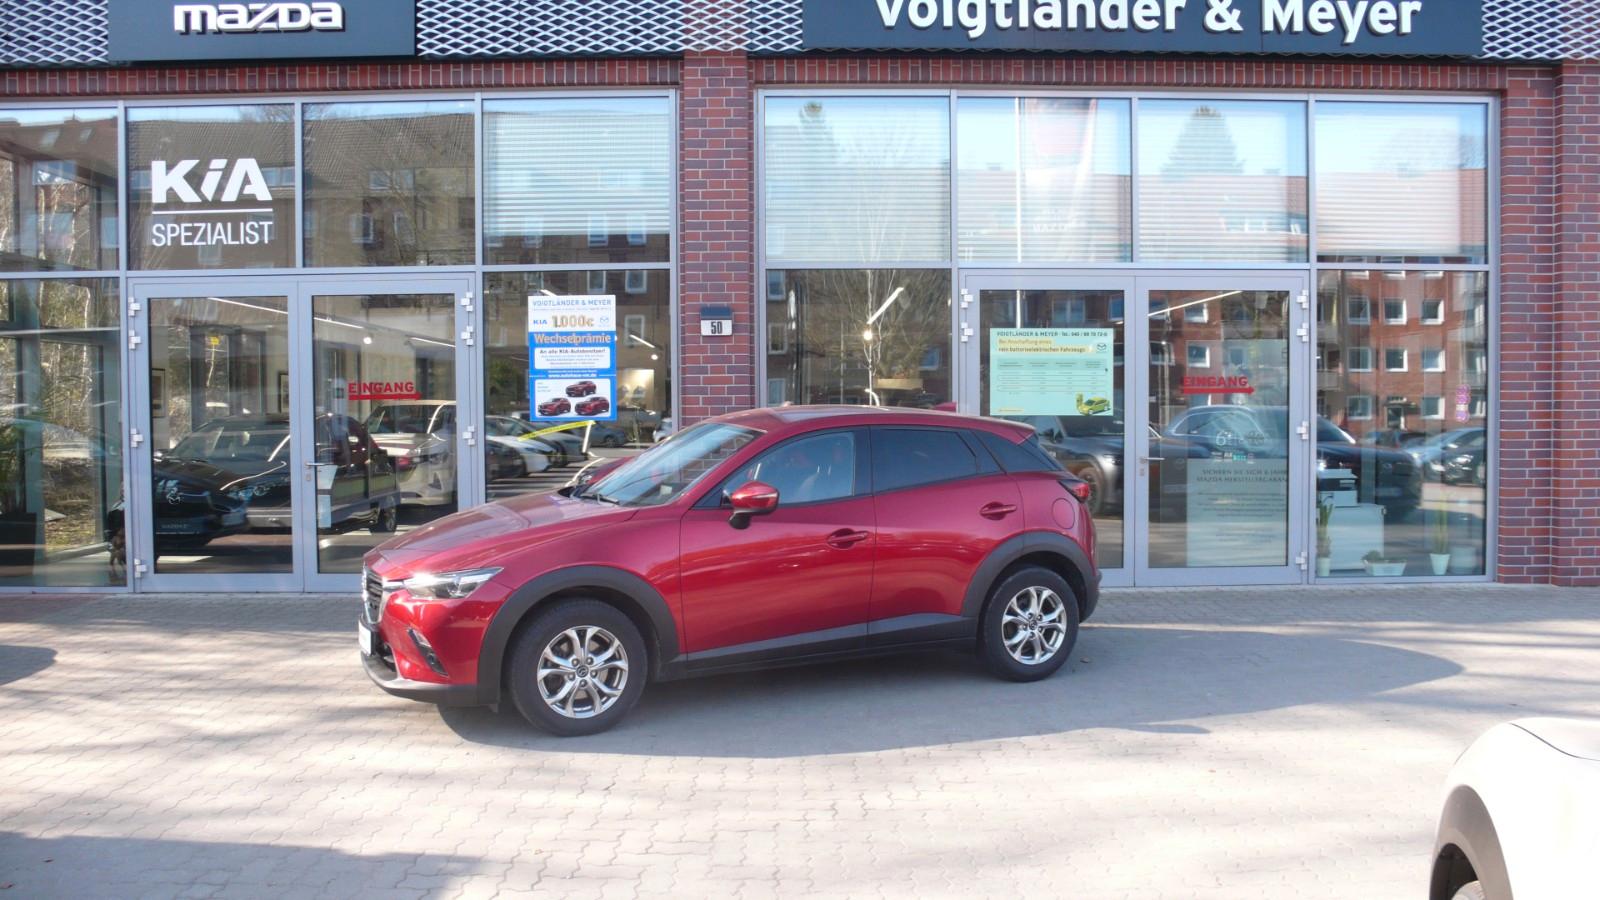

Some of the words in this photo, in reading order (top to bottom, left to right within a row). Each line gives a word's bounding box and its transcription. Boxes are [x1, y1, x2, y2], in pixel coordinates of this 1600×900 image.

[1203, 0, 1243, 32] &
[1262, 0, 1421, 43] Meyer
[152, 221, 273, 247] SPEZIALIST
[711, 321, 723, 334] 50
[534, 333, 611, 346] Wechselprämie
[348, 381, 414, 393] EINGANG
[1183, 376, 1248, 387] EINGANG
